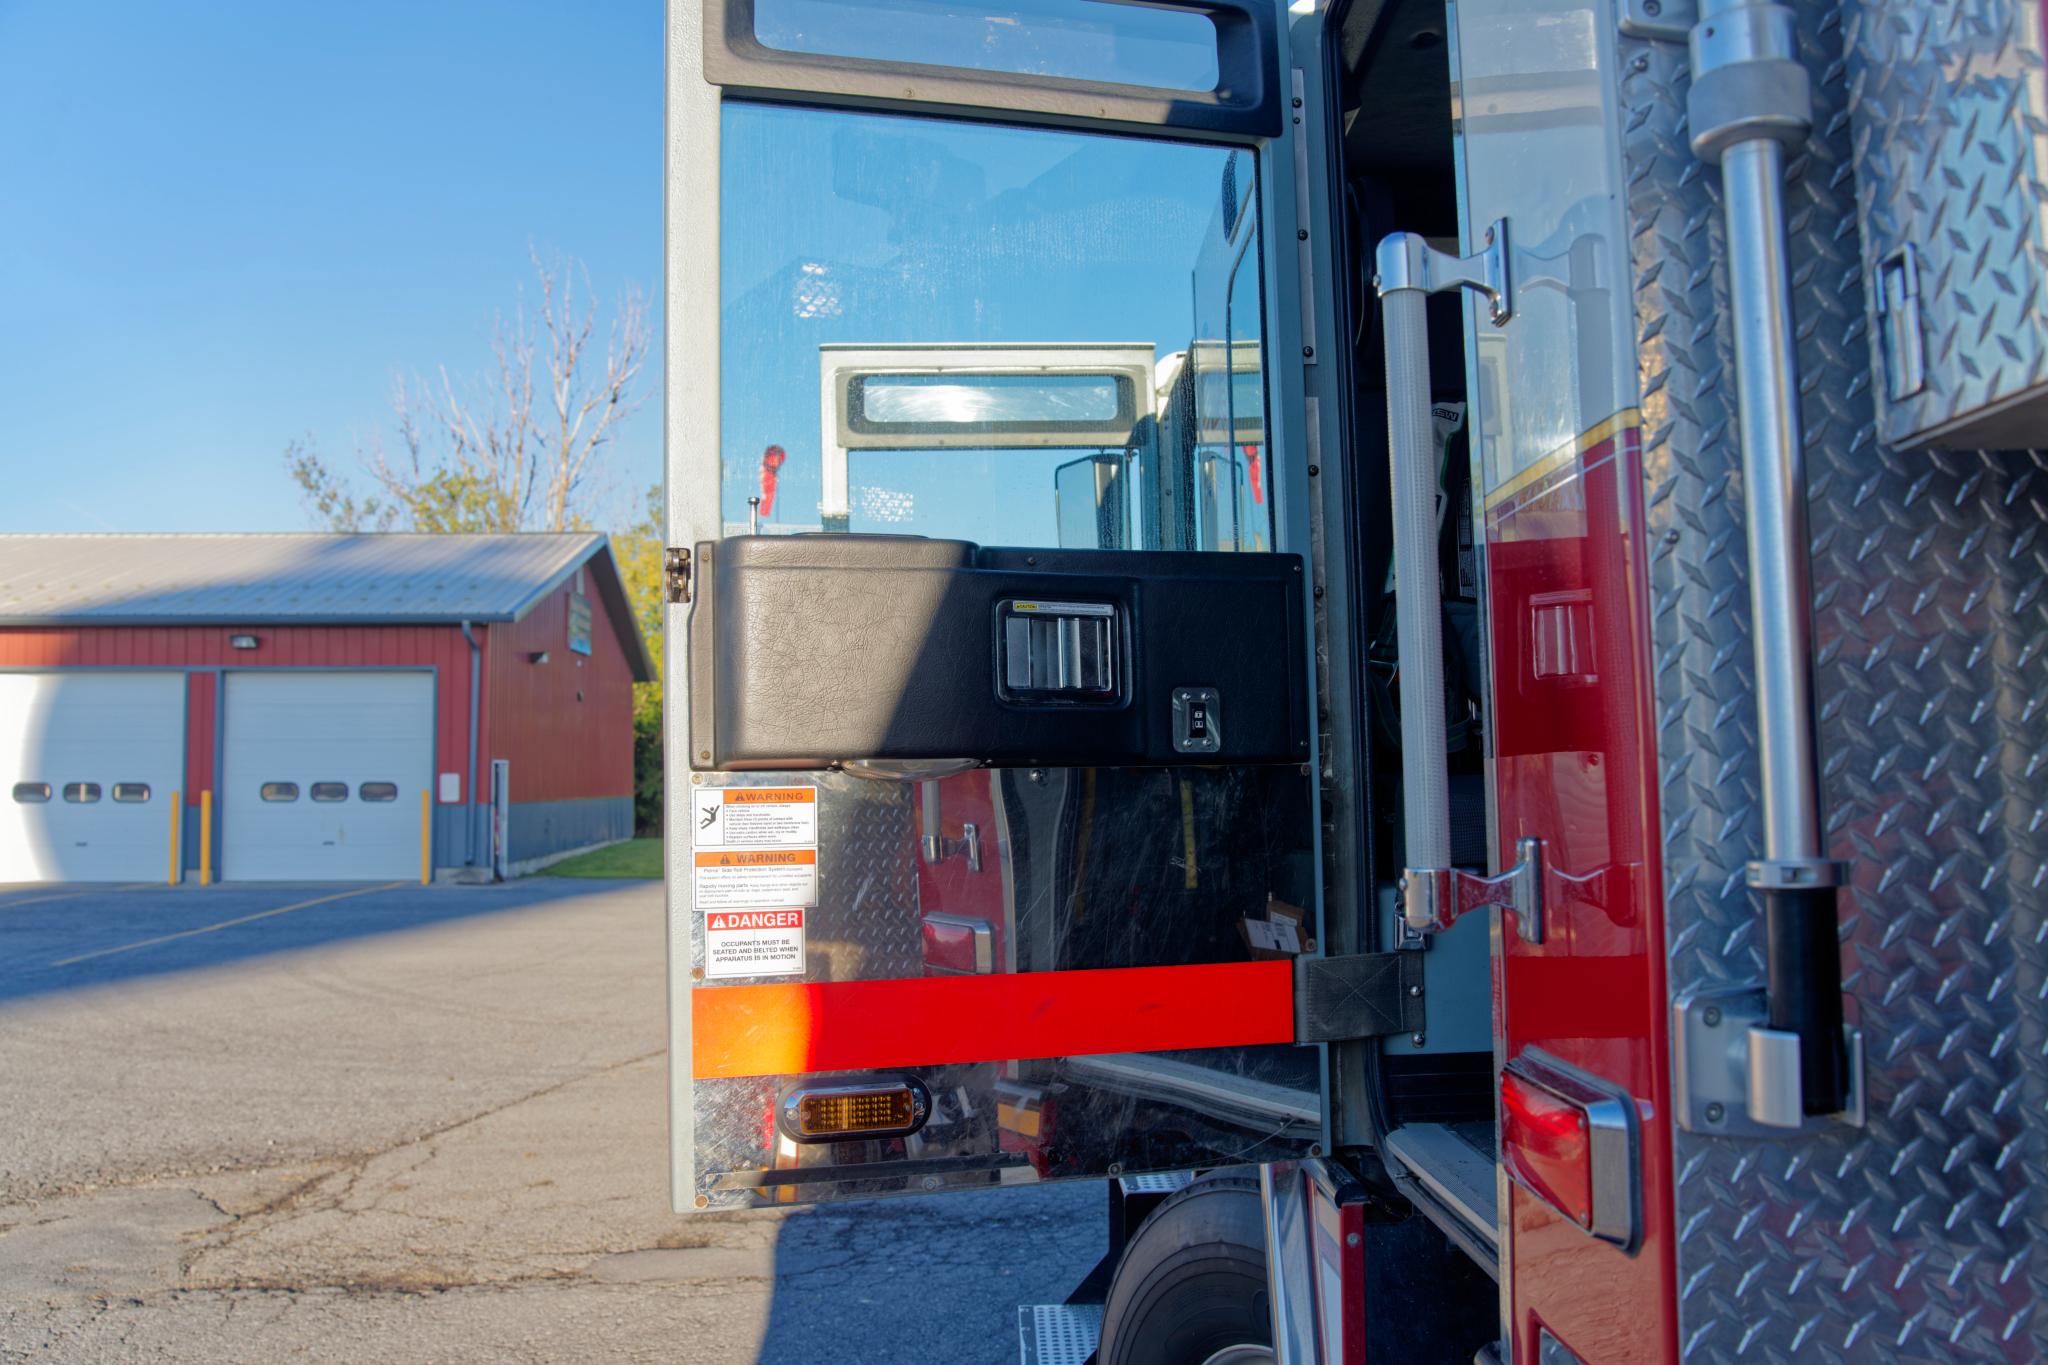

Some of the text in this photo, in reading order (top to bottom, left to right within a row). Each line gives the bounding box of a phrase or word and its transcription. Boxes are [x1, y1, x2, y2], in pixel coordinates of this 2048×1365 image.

[746, 792, 803, 801] WARNING
[736, 853, 796, 863] WARNING
[728, 912, 798, 928] DANGER
